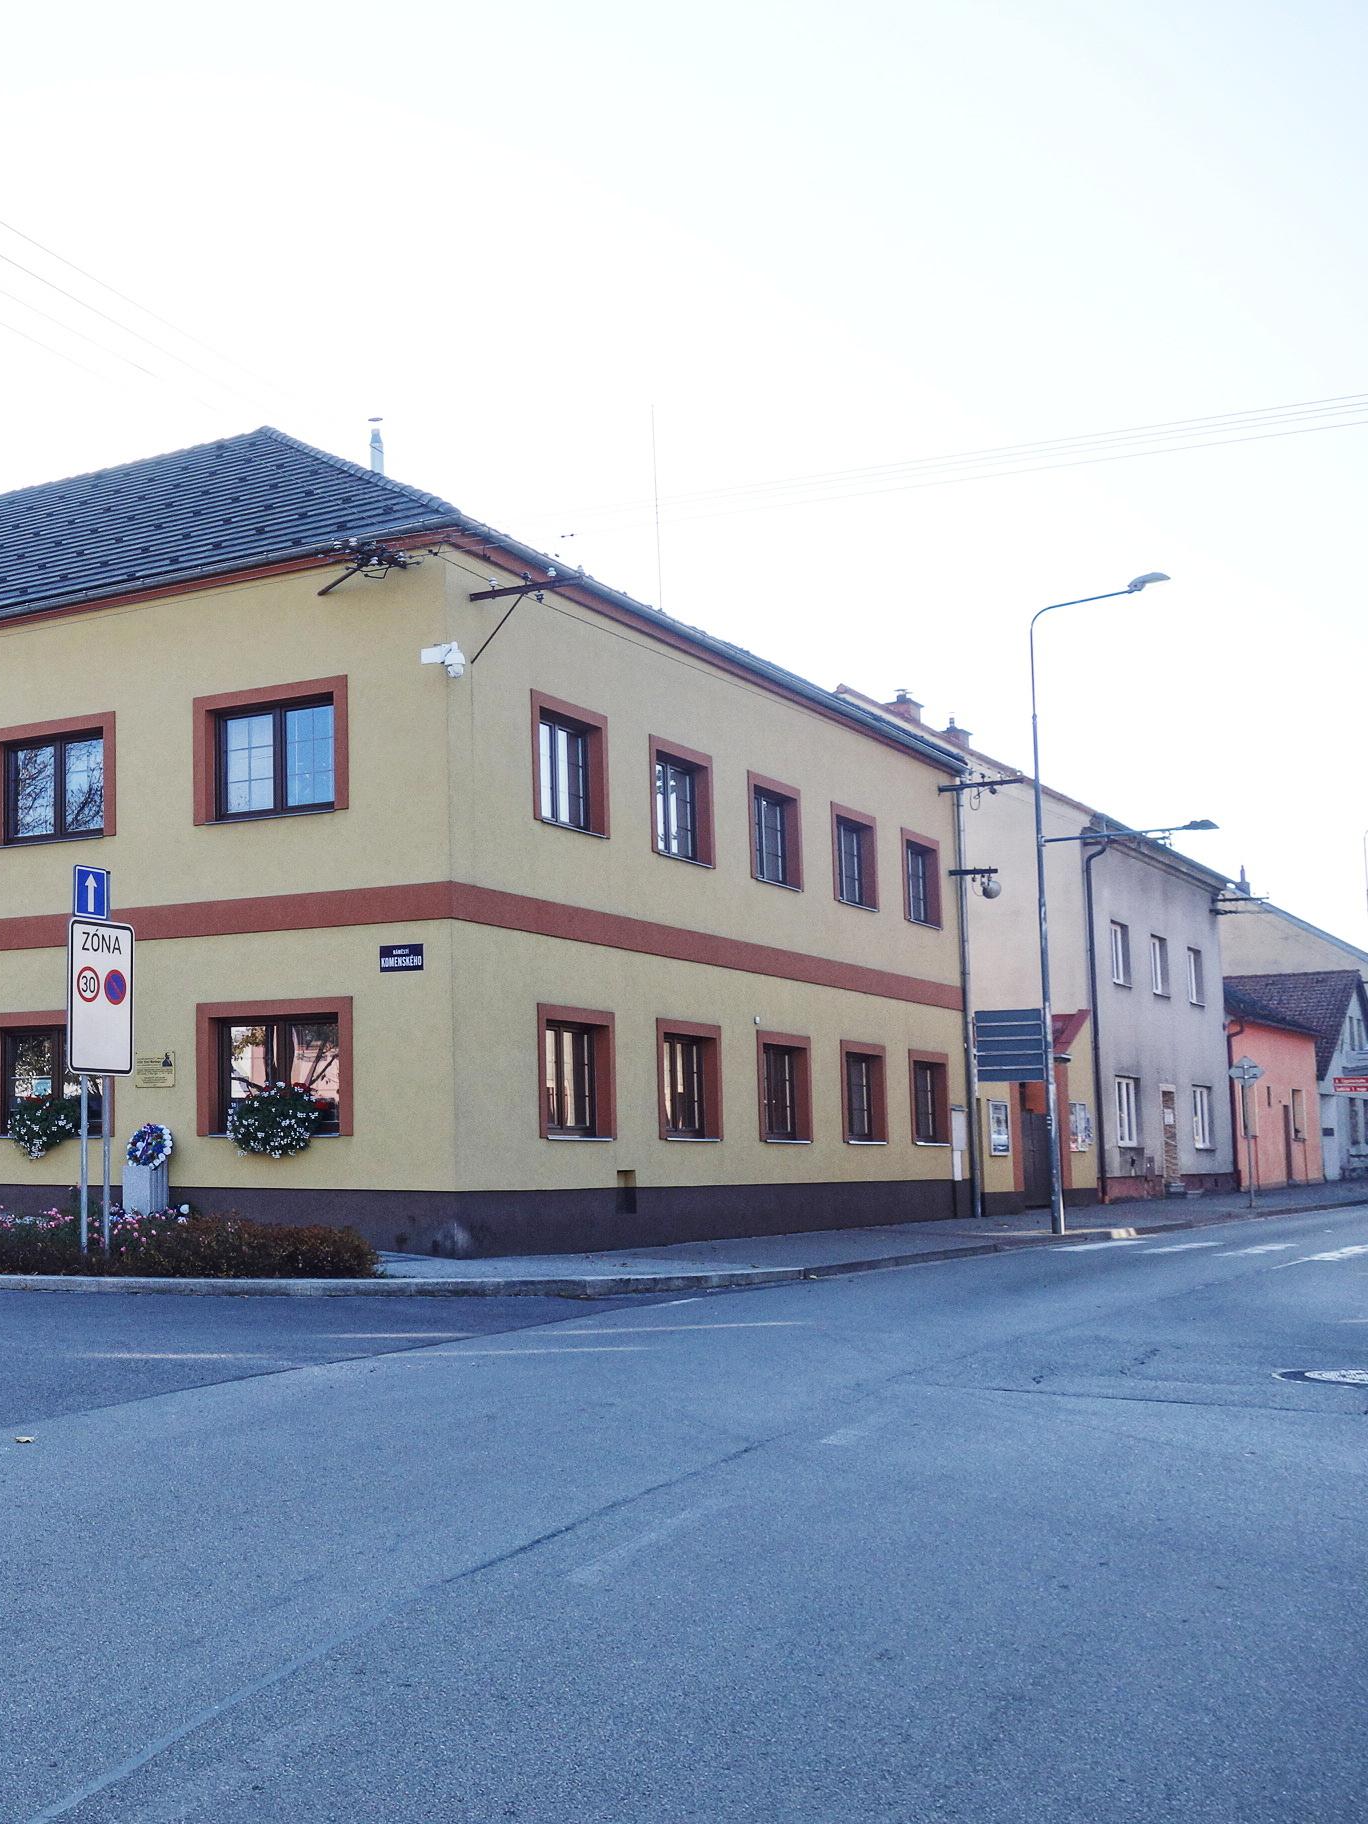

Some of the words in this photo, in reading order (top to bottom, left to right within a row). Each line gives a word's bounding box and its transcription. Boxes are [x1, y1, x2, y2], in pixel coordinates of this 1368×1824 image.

[81, 928, 122, 955] ZÓNA
[381, 955, 422, 967] KOMENSKÉHO
[81, 975, 96, 994] 30
